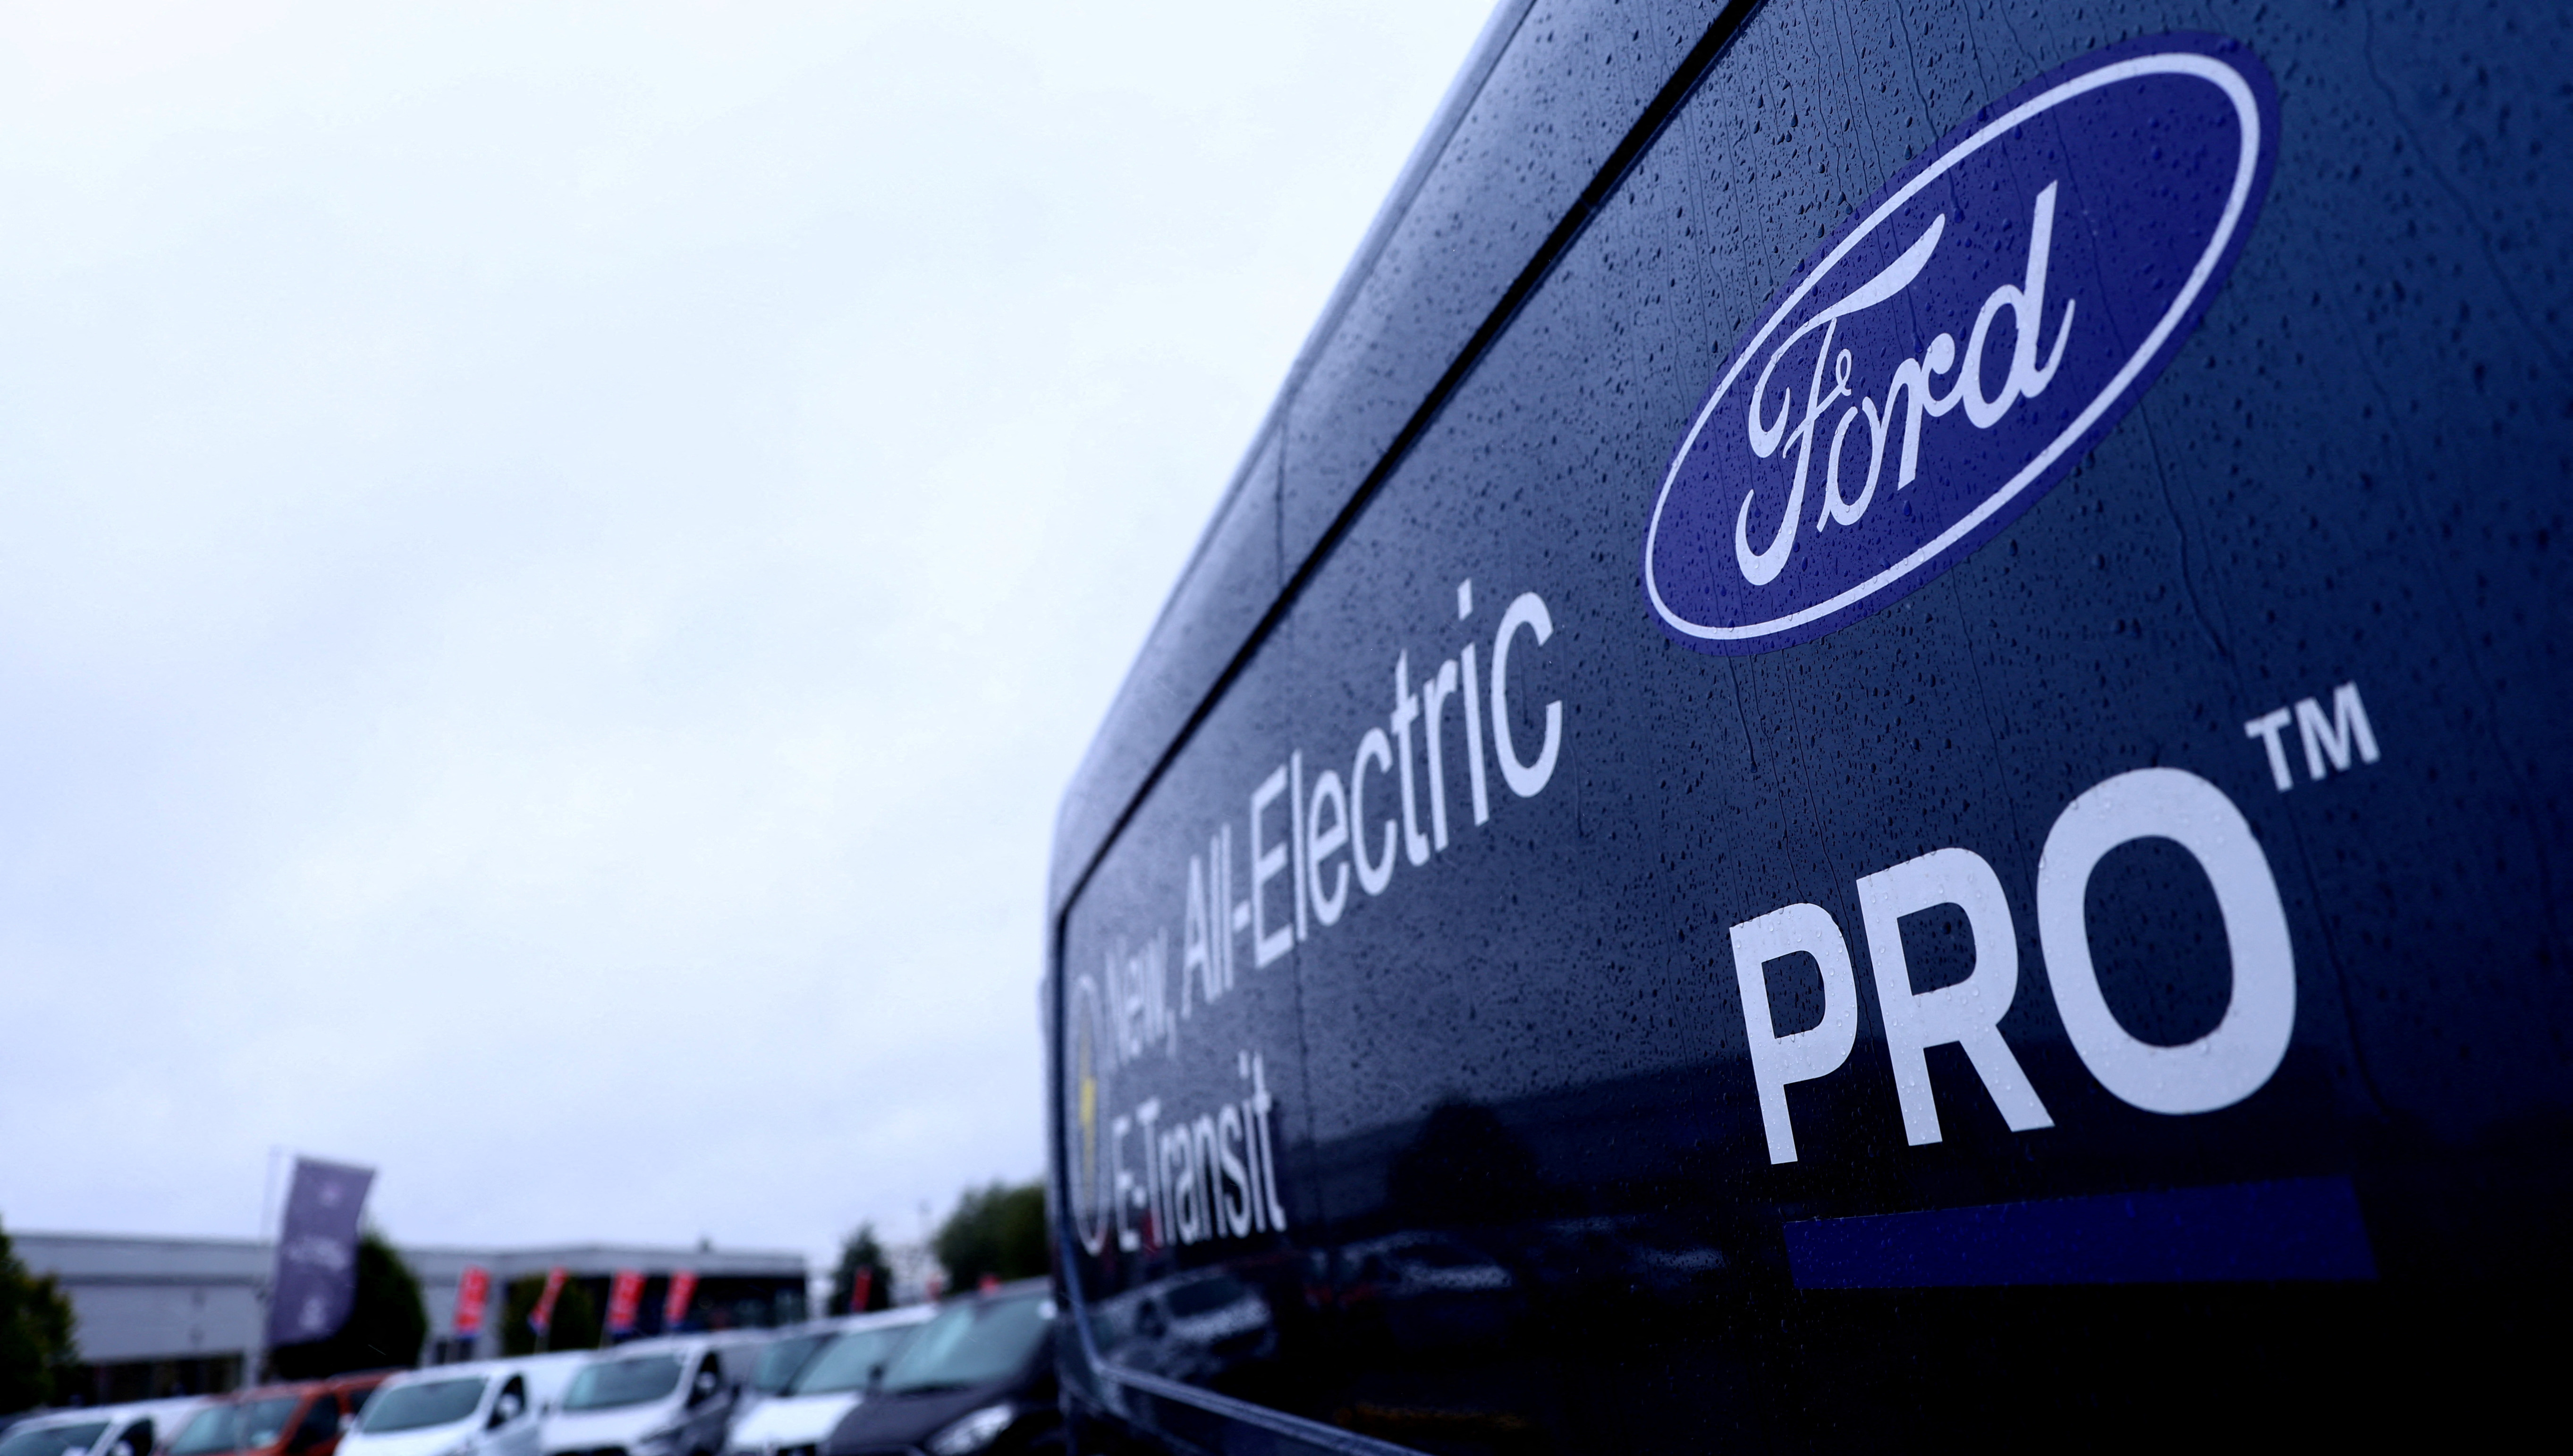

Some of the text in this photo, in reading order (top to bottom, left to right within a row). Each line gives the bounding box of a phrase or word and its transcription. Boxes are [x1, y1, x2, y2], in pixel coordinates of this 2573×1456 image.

[1735, 180, 2075, 585] Ford
[1104, 579, 1562, 1068] New, All-Electric
[1729, 767, 2297, 1164] PRO
[1112, 1051, 1286, 1252] E-Transit
